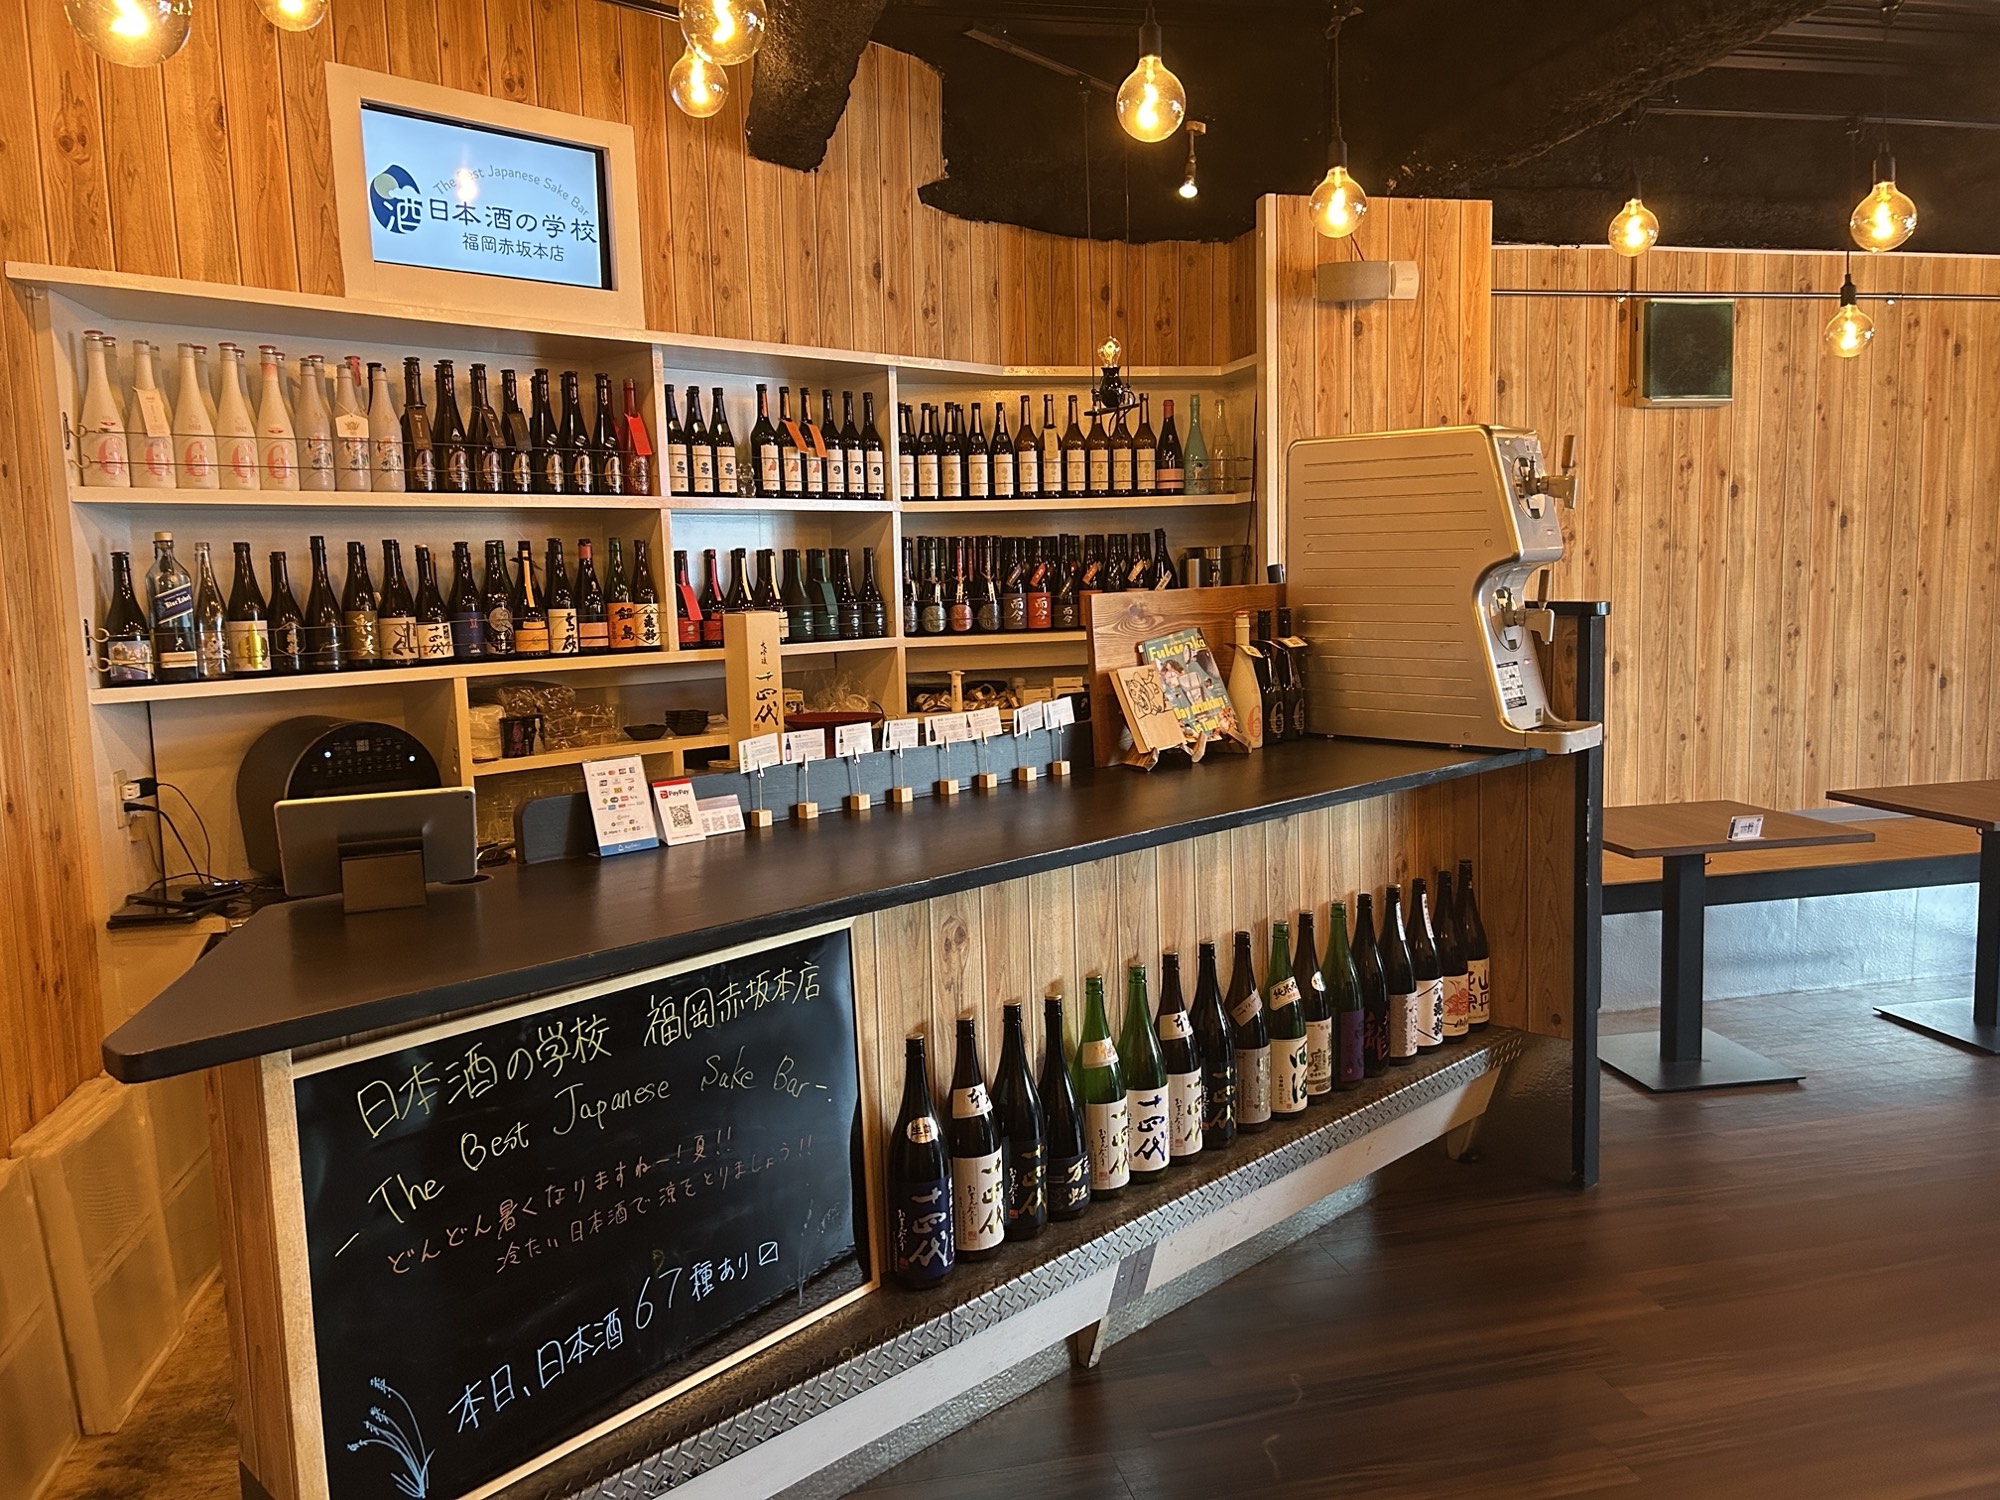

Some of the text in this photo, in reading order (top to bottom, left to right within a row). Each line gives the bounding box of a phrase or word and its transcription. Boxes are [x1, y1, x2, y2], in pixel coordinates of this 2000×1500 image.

[433, 164, 590, 217] The est Japanese Sake Bar
[429, 198, 598, 244] 日本酒の学校
[462, 232, 565, 262] 福岡赤坂本店
[615, 606, 635, 641] 鍋島
[1010, 597, 1024, 621] 而今
[1035, 597, 1048, 620] 而今
[1062, 606, 1074, 623] 而今
[755, 671, 779, 726] 十四代
[668, 789, 690, 798] PayPay
[357, 961, 821, 1140] 日本酒の学校 福岡赤坂本店
[367, 1172, 445, 1226] The
[460, 1121, 530, 1172] Best
[553, 1079, 671, 1137] Japanese
[699, 1045, 757, 1092] Sake
[1134, 1094, 1167, 1161] 十四代
[909, 1186, 948, 1268] 十四代
